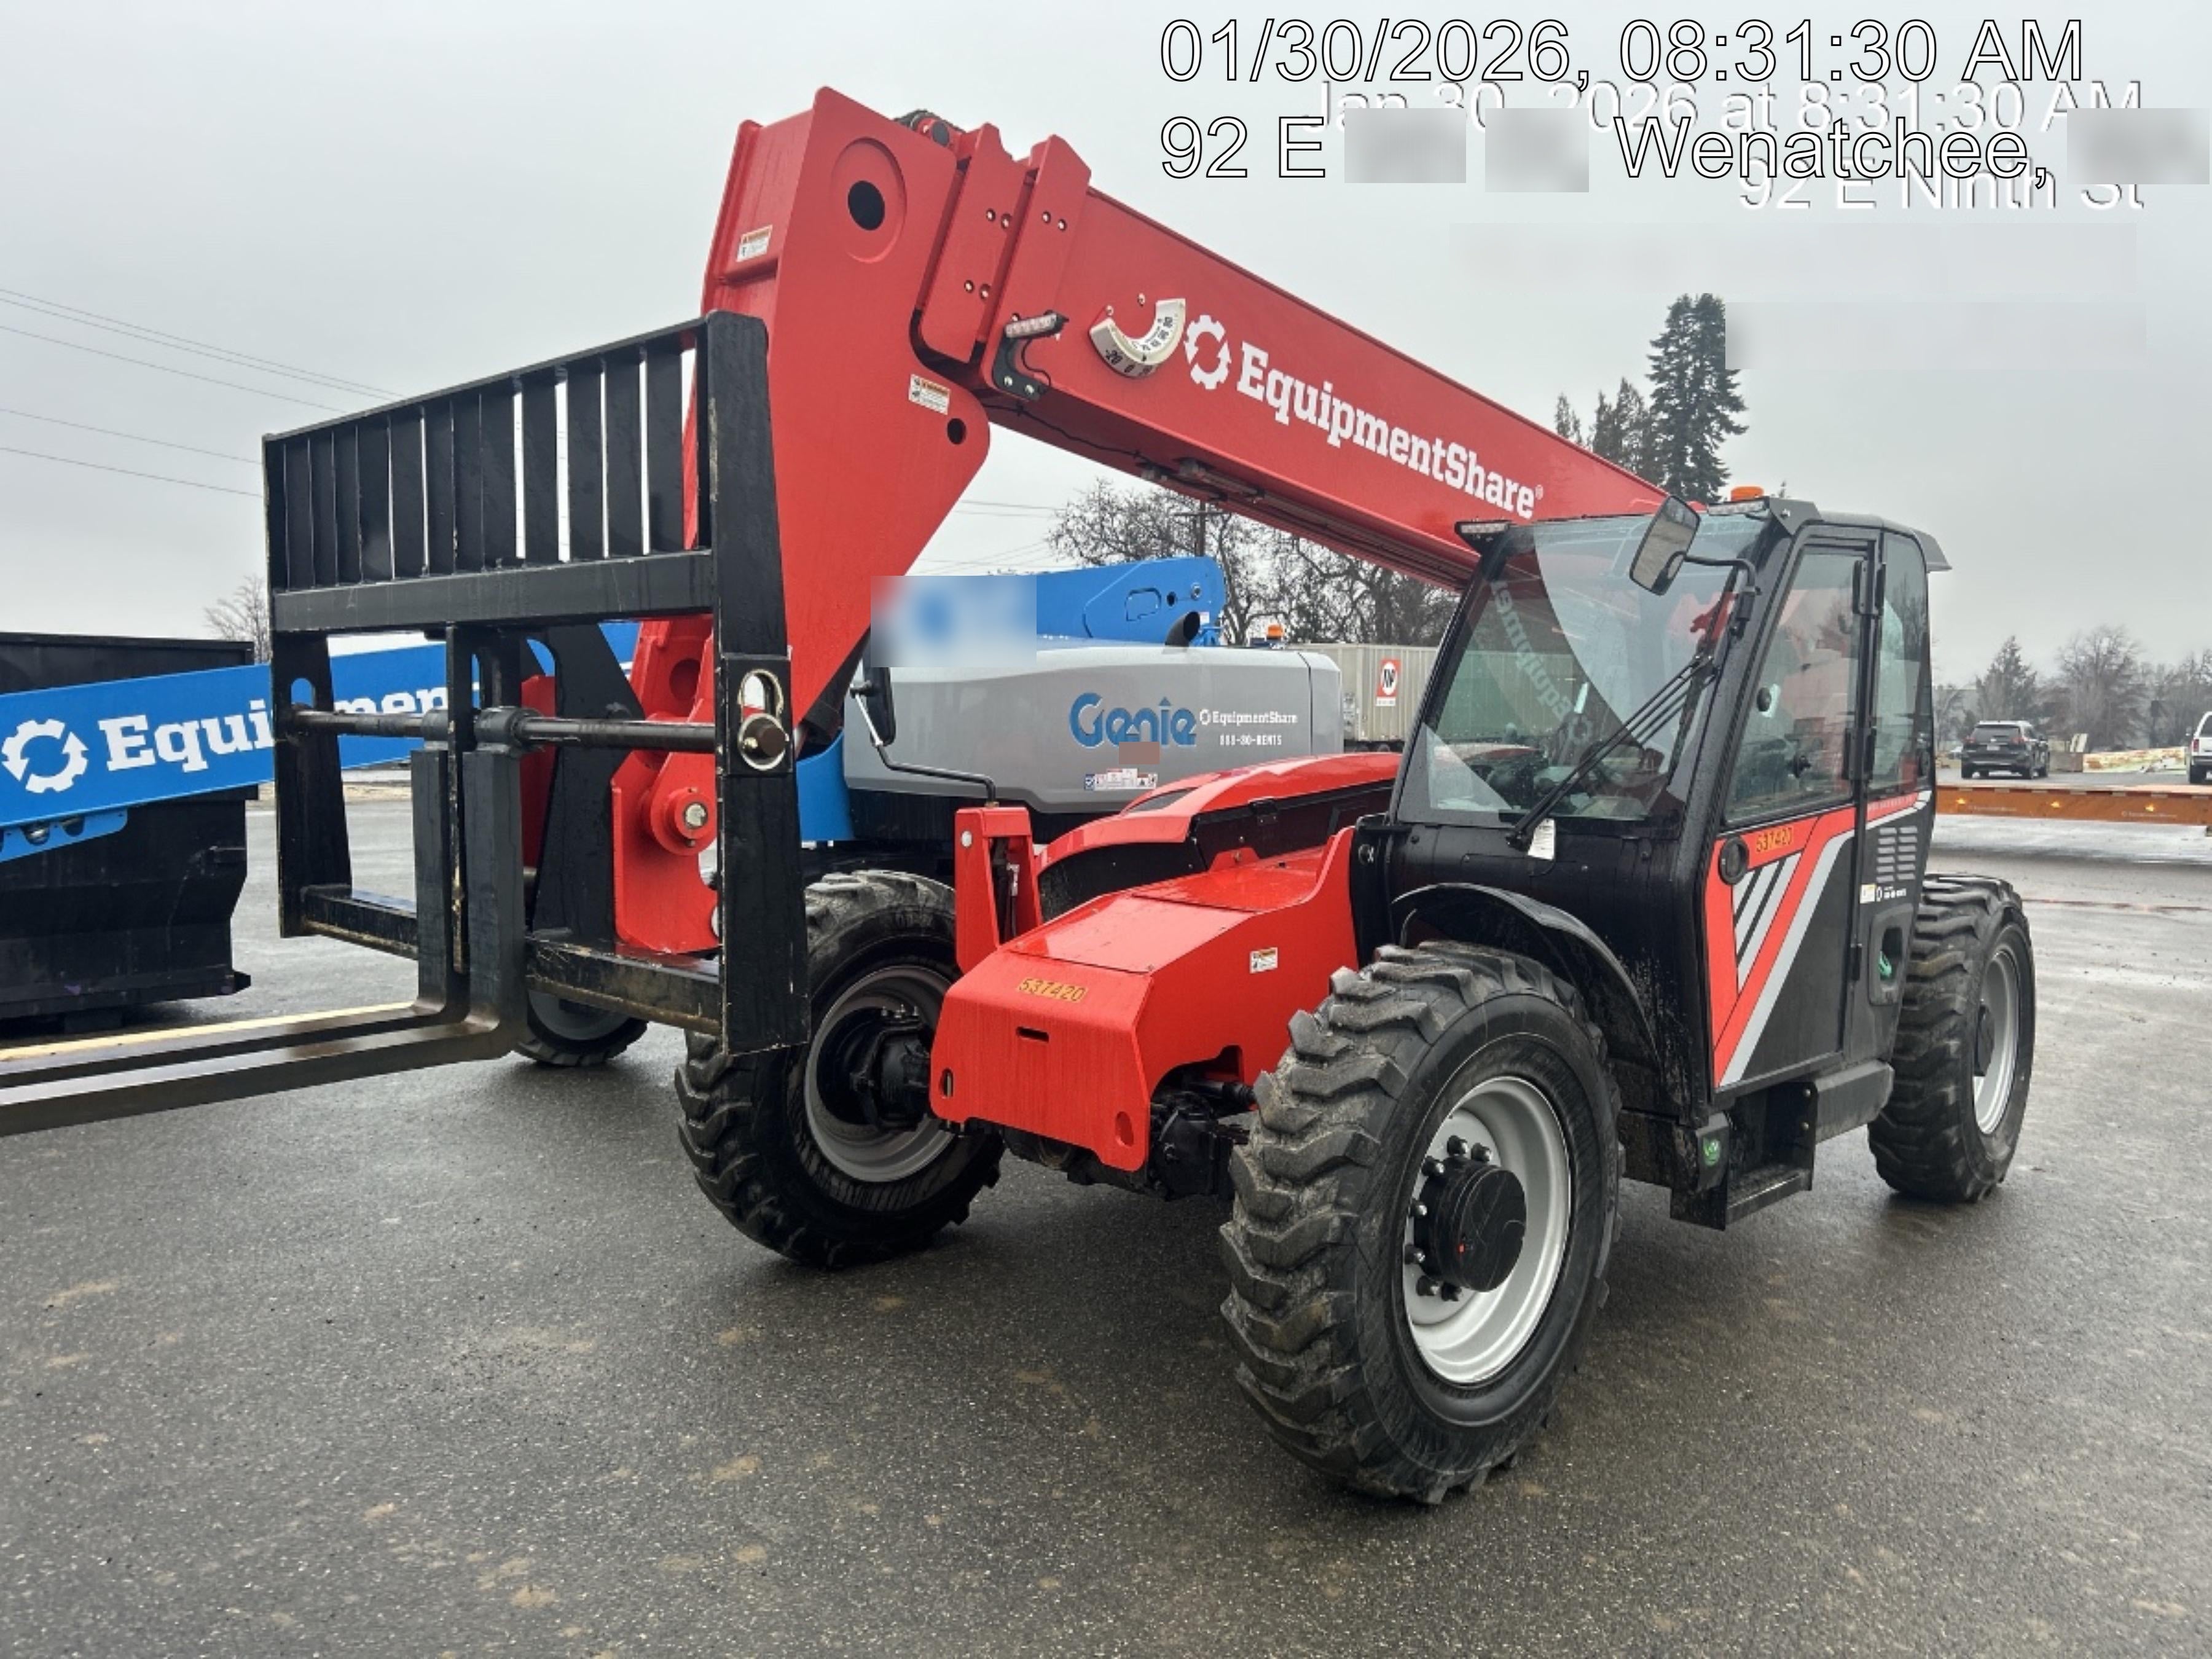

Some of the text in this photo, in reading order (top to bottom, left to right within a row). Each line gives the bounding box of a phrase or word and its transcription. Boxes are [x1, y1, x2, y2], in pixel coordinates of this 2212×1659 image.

[1069, 692, 1197, 748] Genie
[1212, 710, 1298, 727] EquipmentShare
[1018, 978, 1086, 1002] 537420
